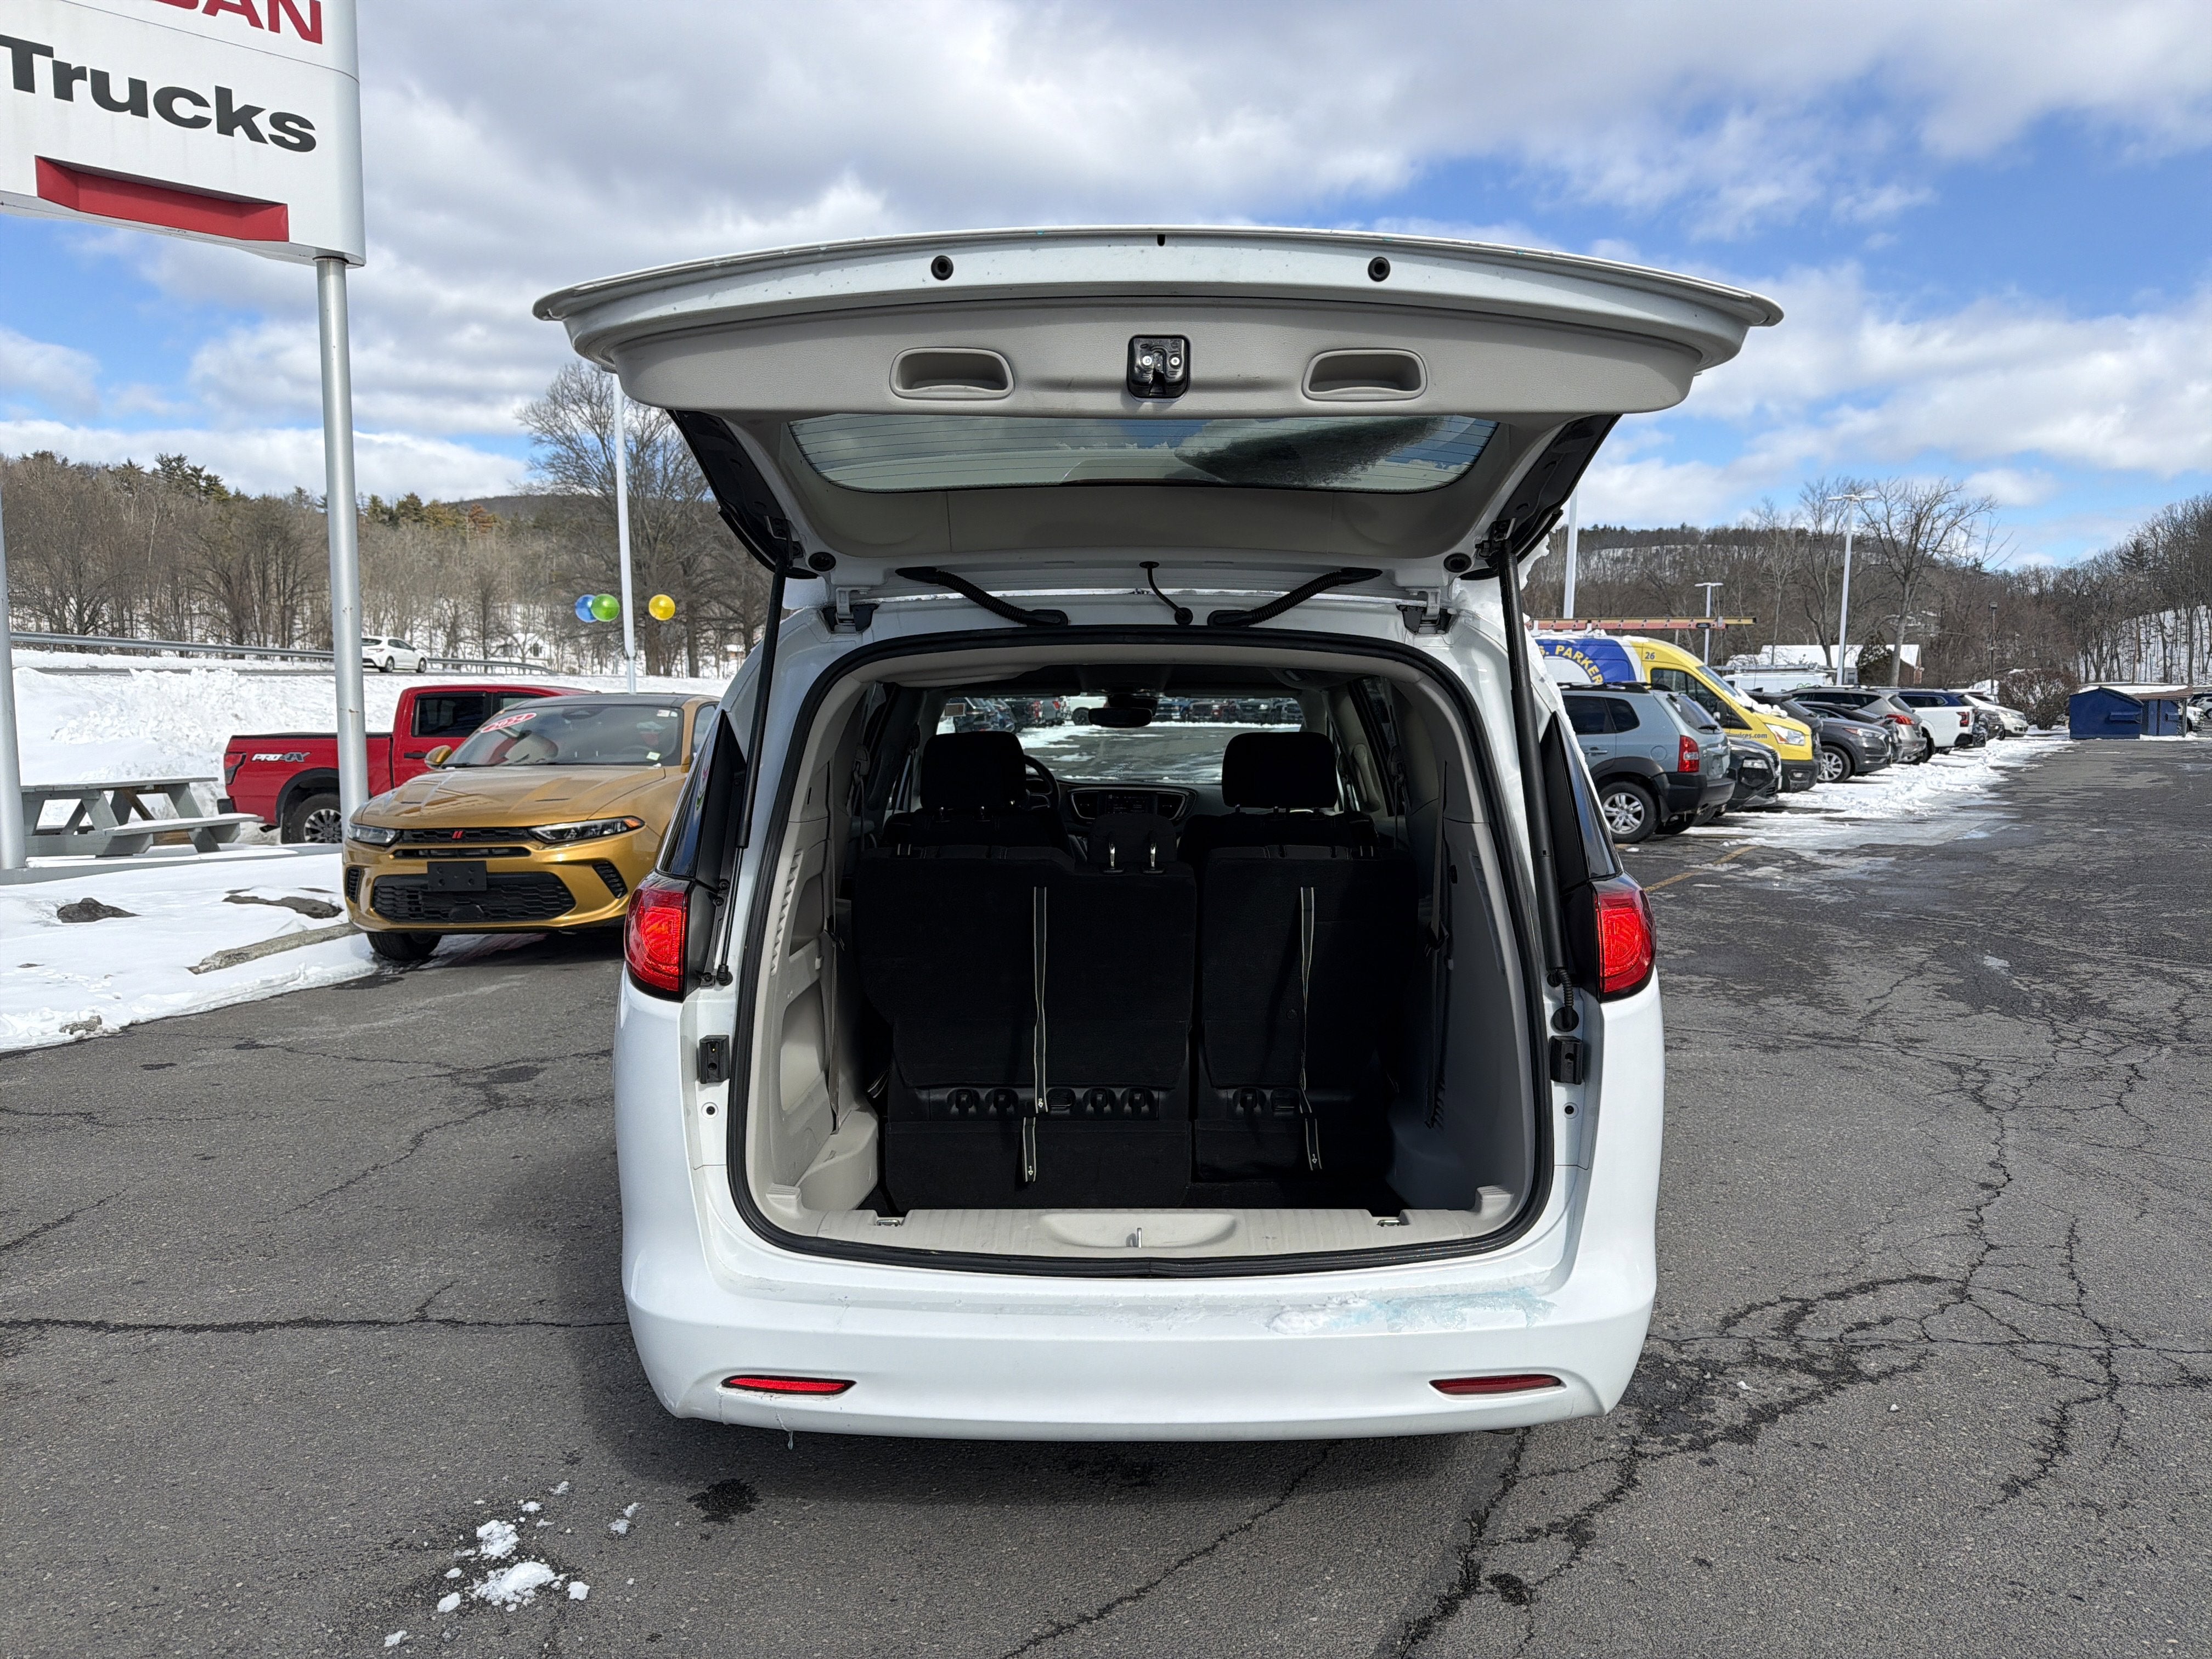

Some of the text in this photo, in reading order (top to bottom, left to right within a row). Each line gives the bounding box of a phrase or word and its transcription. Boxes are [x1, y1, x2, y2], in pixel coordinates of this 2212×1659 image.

[153, 0, 323, 44] AN
[0, 34, 317, 153] Trucks
[1555, 645, 1603, 685] PARKER
[1645, 651, 1655, 659] 26
